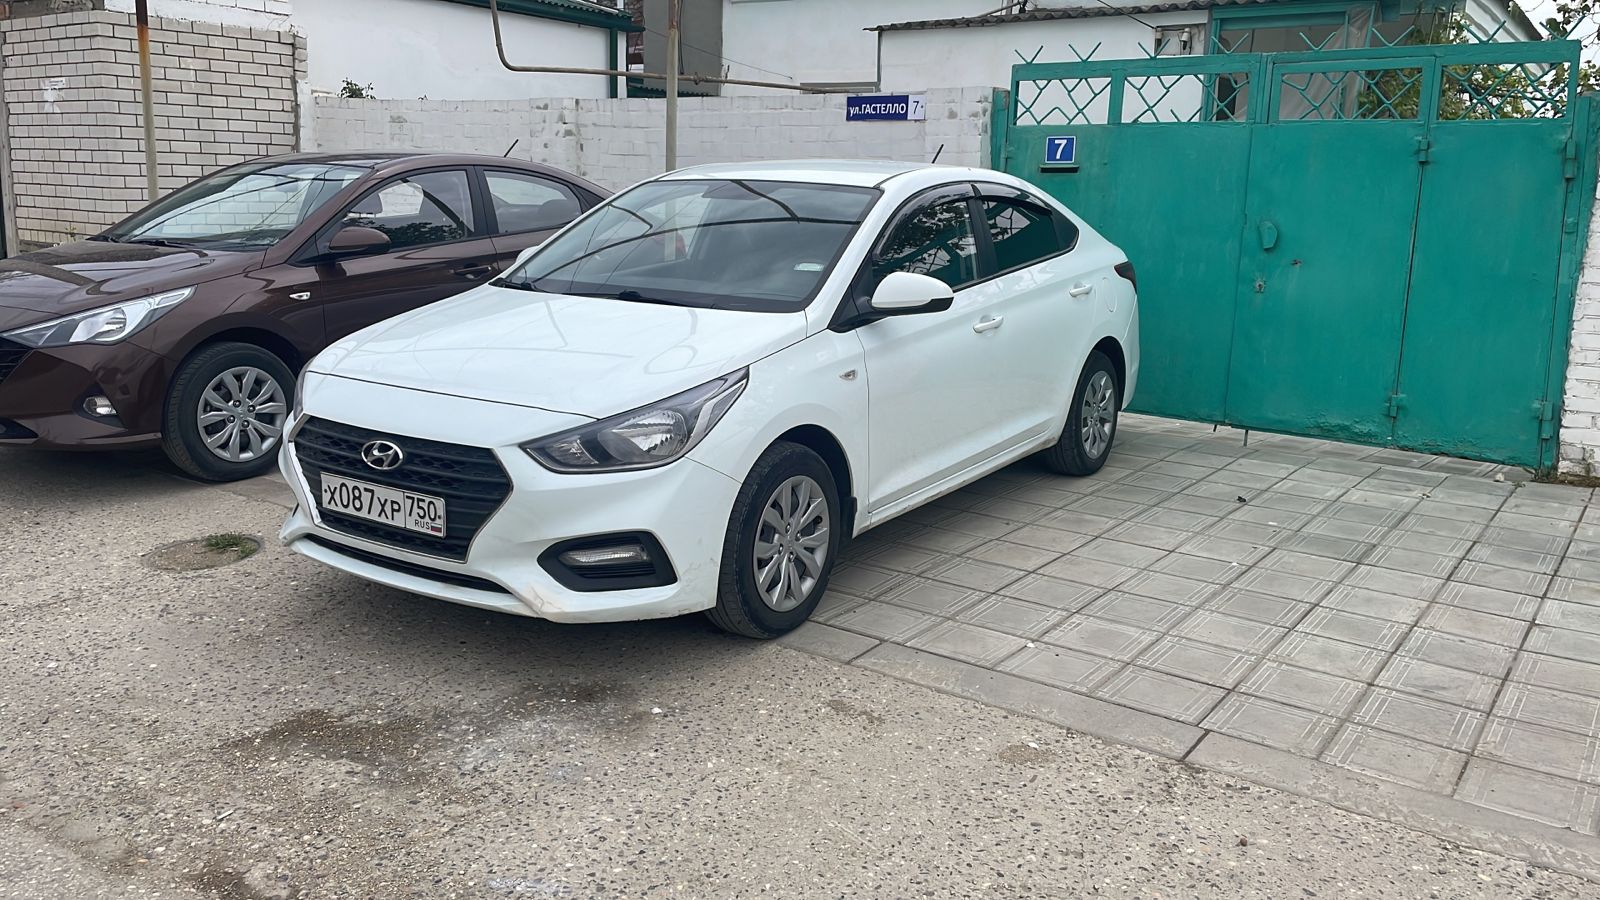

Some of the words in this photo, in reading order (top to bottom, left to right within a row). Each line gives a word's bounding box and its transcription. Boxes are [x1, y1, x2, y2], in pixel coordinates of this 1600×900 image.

[912, 100, 920, 115] 7
[1054, 139, 1068, 160] 7
[405, 495, 438, 522] 750
[414, 519, 430, 530] RUS
